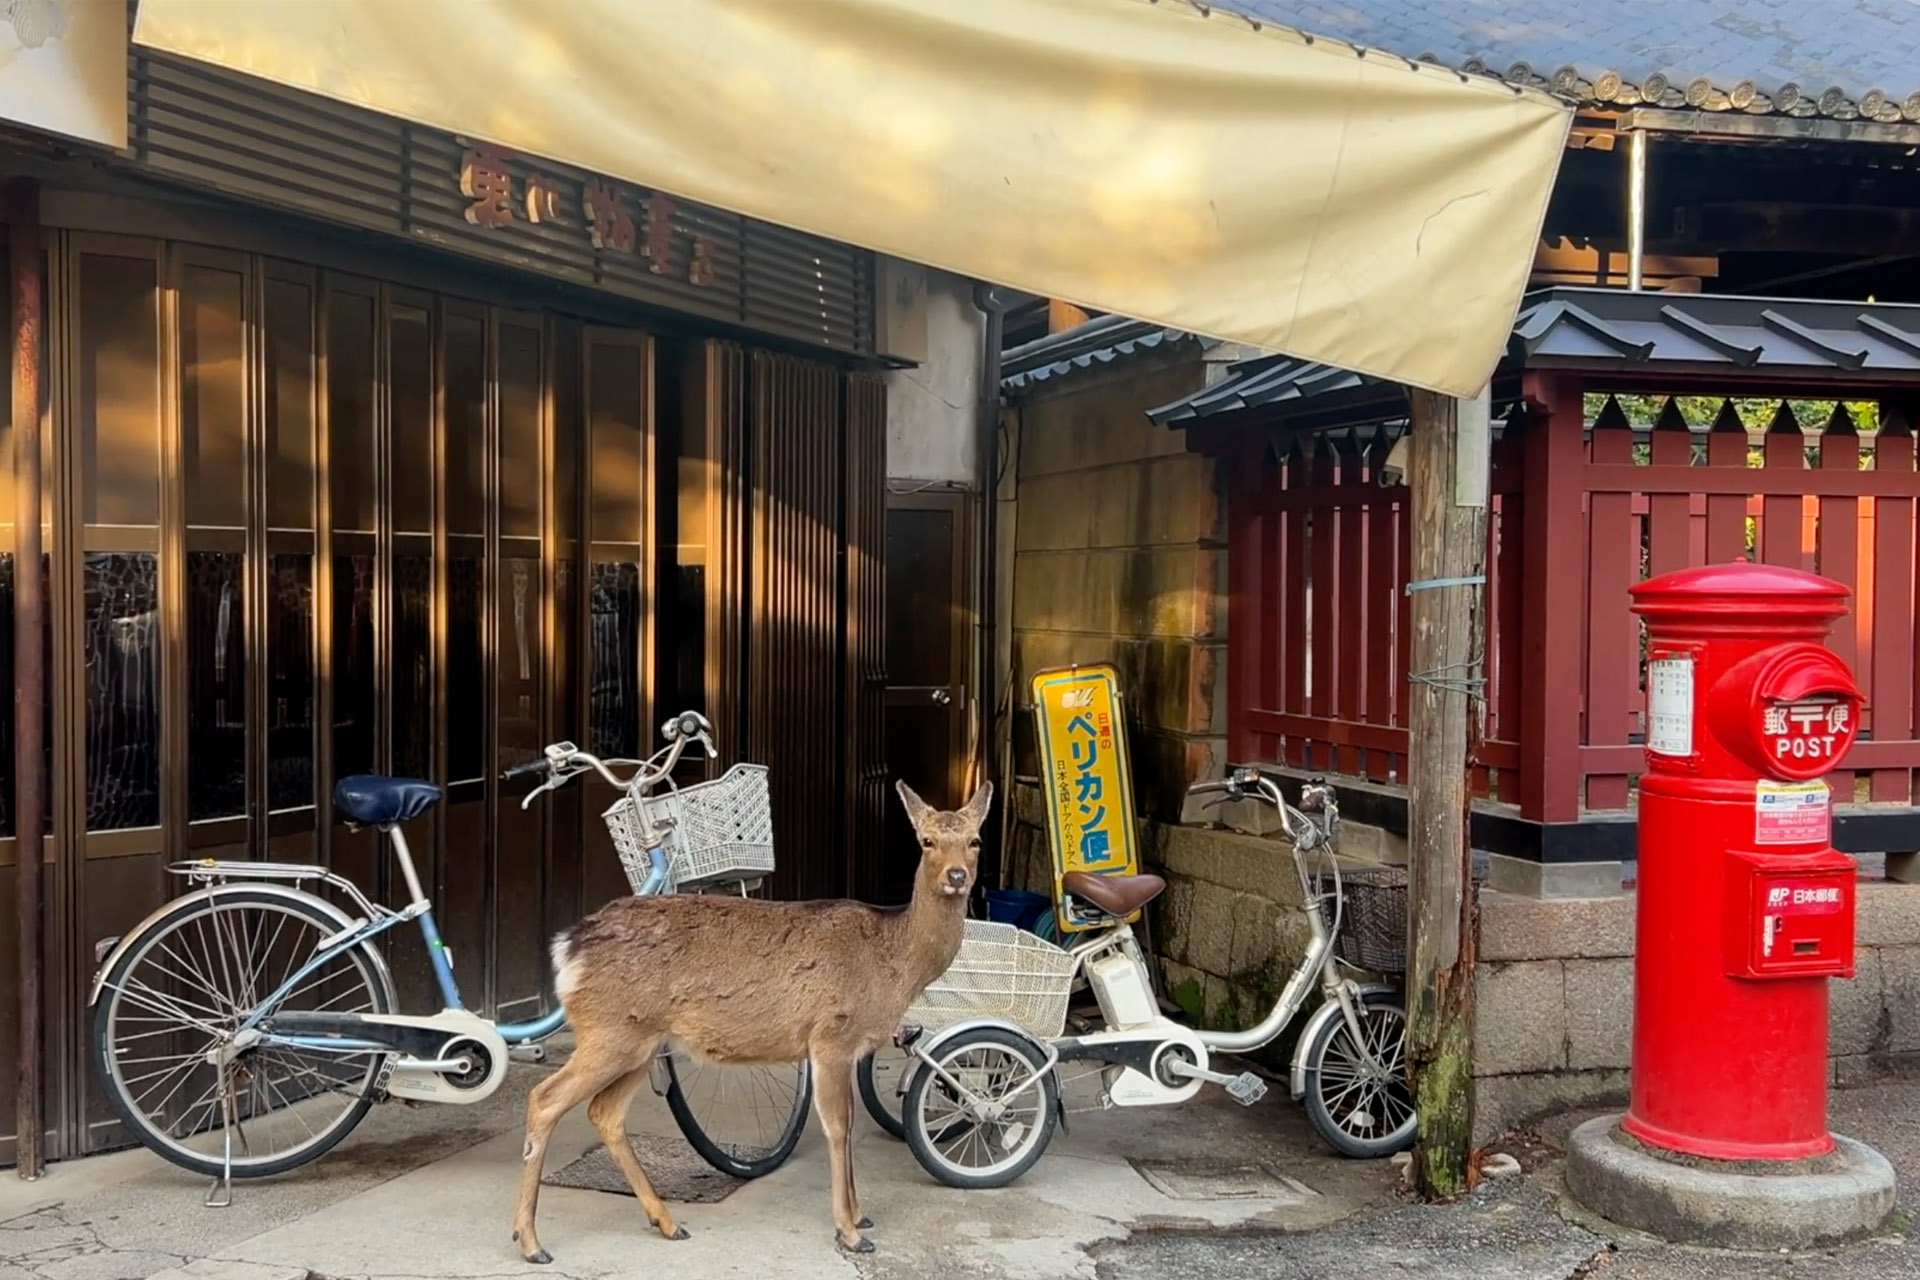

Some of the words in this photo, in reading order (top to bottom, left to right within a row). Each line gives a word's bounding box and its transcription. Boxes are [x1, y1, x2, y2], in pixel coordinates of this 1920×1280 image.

[1776, 737, 1836, 758] POST
[1057, 760, 1077, 866] 日本全国ドアからドアへ
[1067, 711, 1111, 864] ペリカン便
[1793, 888, 1840, 904] 日本郵便
